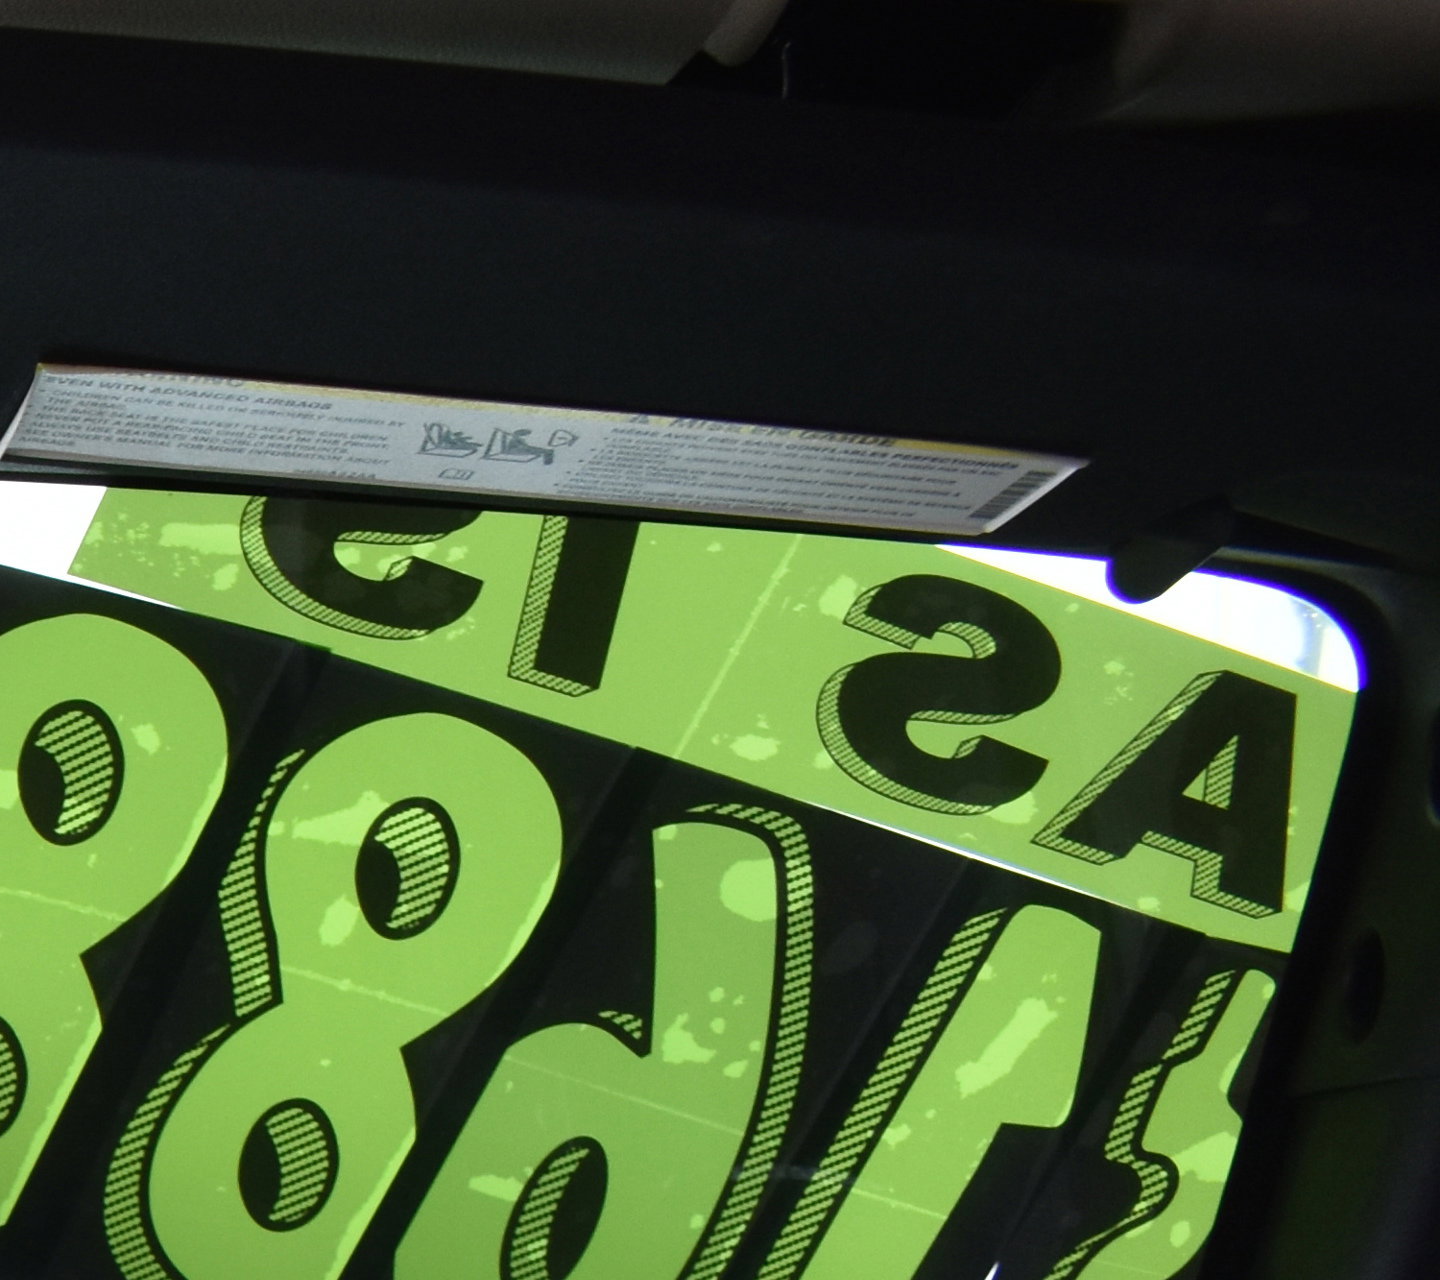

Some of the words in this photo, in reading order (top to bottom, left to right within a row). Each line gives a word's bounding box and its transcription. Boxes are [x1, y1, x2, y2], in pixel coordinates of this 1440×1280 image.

[46, 376, 94, 387] EVEN
[99, 381, 144, 393] WITH
[149, 386, 249, 402] ADVANCED
[254, 398, 333, 410] AIRBAGS
